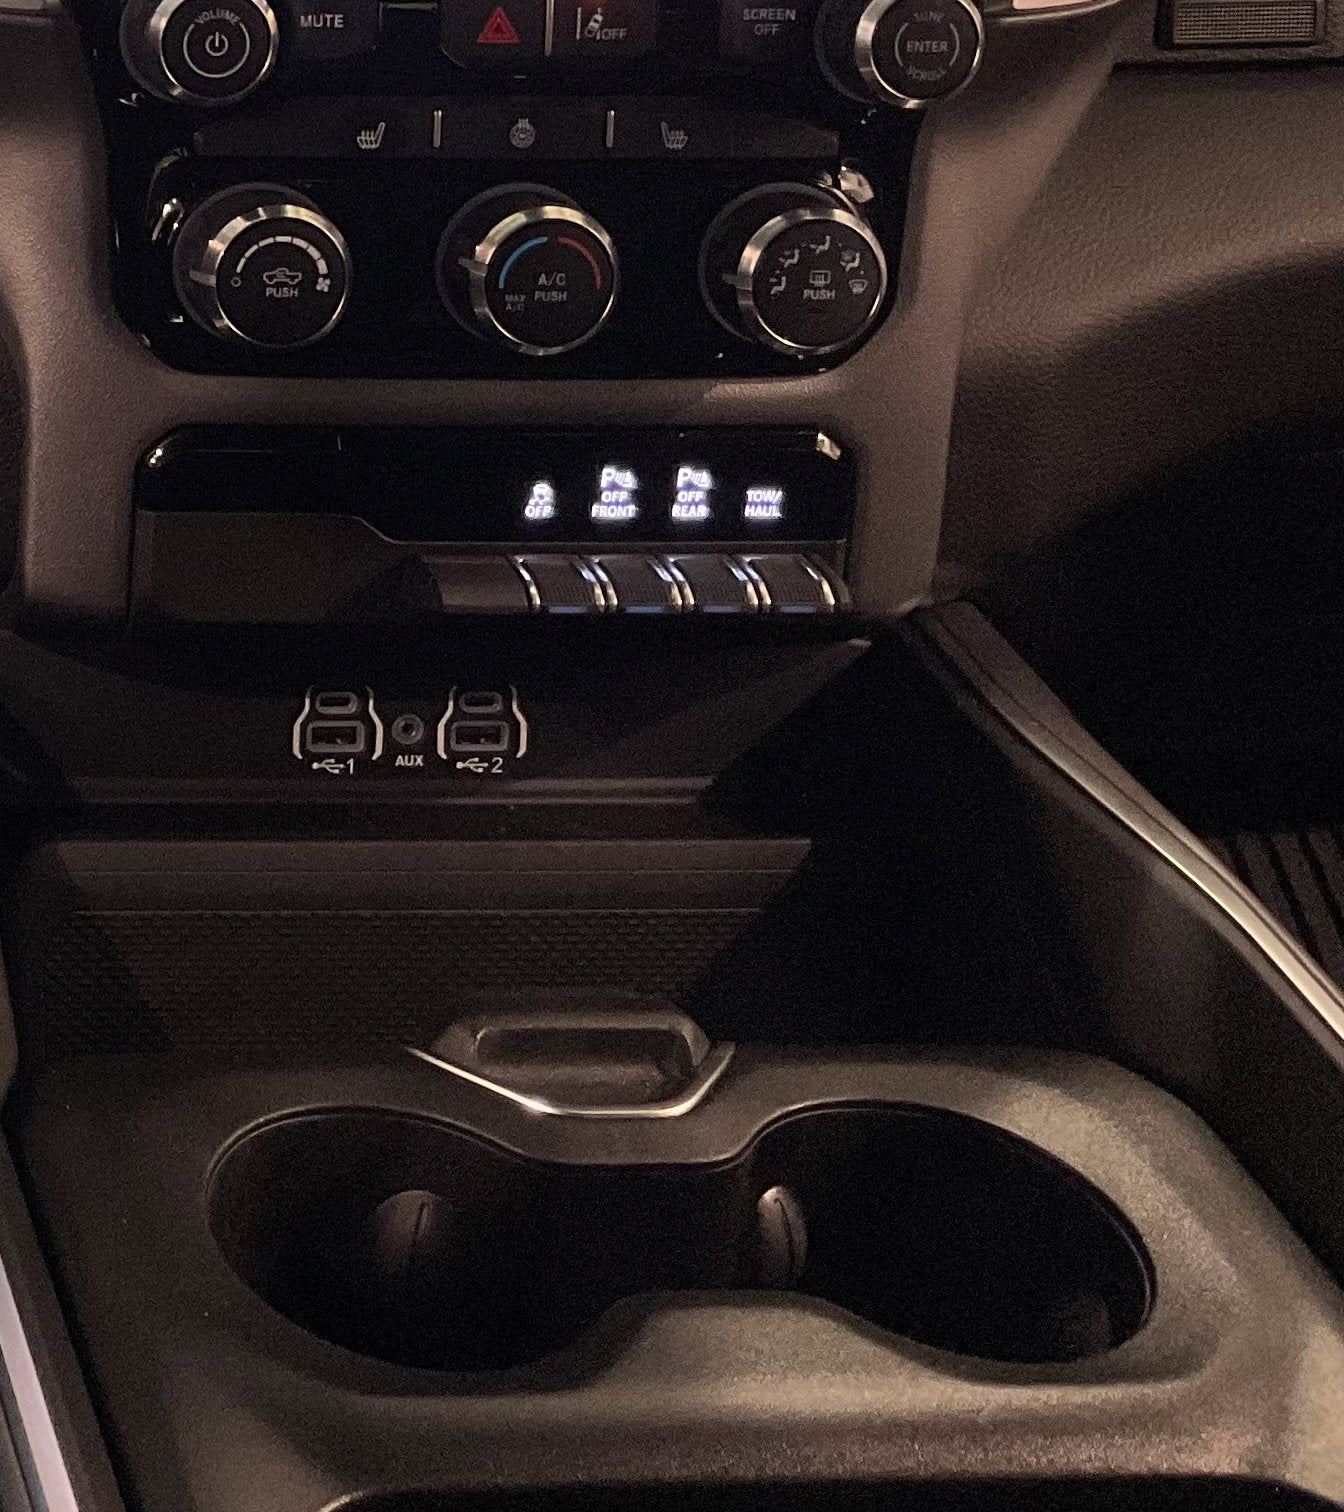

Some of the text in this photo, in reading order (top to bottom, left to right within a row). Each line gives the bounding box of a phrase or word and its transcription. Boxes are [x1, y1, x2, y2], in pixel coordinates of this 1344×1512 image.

[193, 7, 242, 26] VOLUME
[300, 14, 345, 29] MUTE
[742, 7, 797, 22] SCREEN
[601, 28, 628, 41] OFF
[754, 22, 780, 36] OFF
[906, 40, 948, 53] ENTER
[537, 271, 566, 286] A/C
[265, 286, 299, 299] PUSH
[534, 290, 567, 302] PUSH
[803, 288, 835, 300] PUSH
[600, 490, 628, 503] OFF
[677, 490, 703, 503] OFF
[524, 504, 553, 518] OFF
[591, 504, 636, 518] FRONT
[671, 504, 708, 518] REAR
[744, 504, 782, 518] HAUL
[346, 758, 355, 775] 1
[394, 754, 424, 767] AUX
[490, 757, 503, 774] 2
